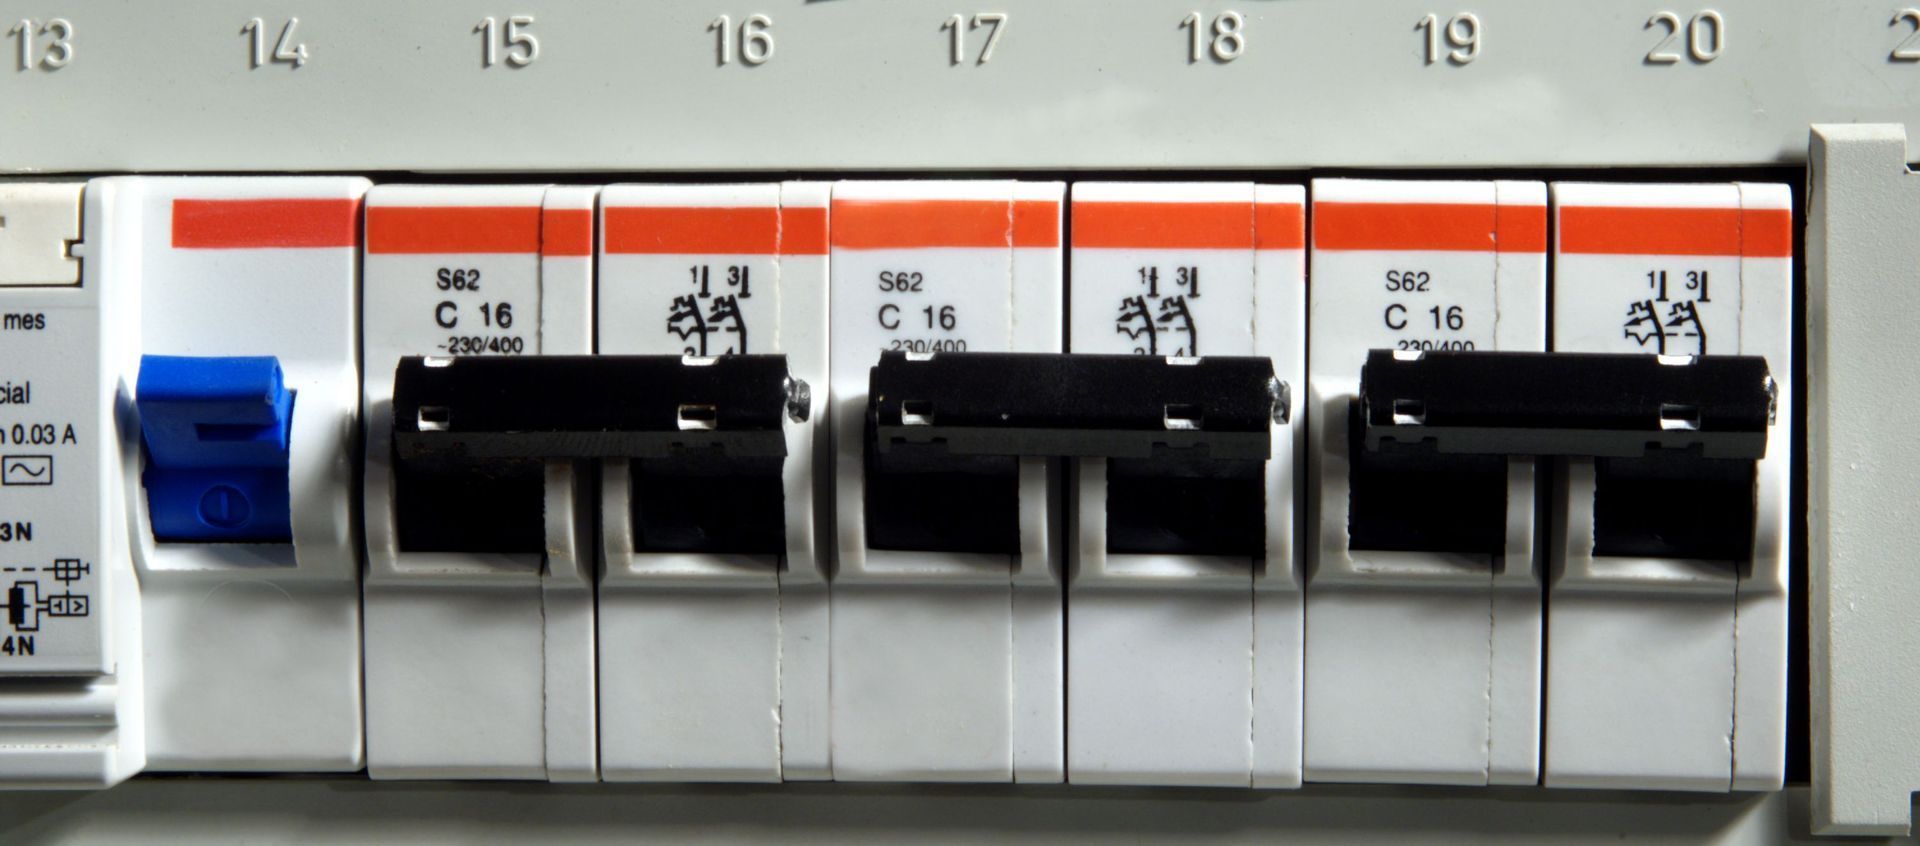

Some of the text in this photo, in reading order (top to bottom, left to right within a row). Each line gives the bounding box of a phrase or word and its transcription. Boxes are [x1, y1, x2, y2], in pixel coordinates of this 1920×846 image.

[7, 18, 73, 71] 13
[240, 17, 308, 68] 14
[473, 15, 540, 68] 15
[706, 14, 775, 66] 16
[940, 13, 1008, 65] 17
[1179, 11, 1245, 63] 18
[1415, 12, 1481, 65] 19
[1642, 10, 1724, 64] 20
[437, 268, 480, 291] S62
[690, 265, 739, 286] 1 3
[879, 271, 922, 292] S62
[1138, 266, 1188, 286] 1 3
[1386, 270, 1430, 292] S62
[1647, 270, 1698, 290] 1 3
[4, 313, 45, 330] mes
[436, 301, 512, 328] C 16
[878, 303, 956, 331] C 16
[1385, 304, 1463, 331] C 16
[12, 423, 55, 445] 0.03
[62, 423, 77, 444] A
